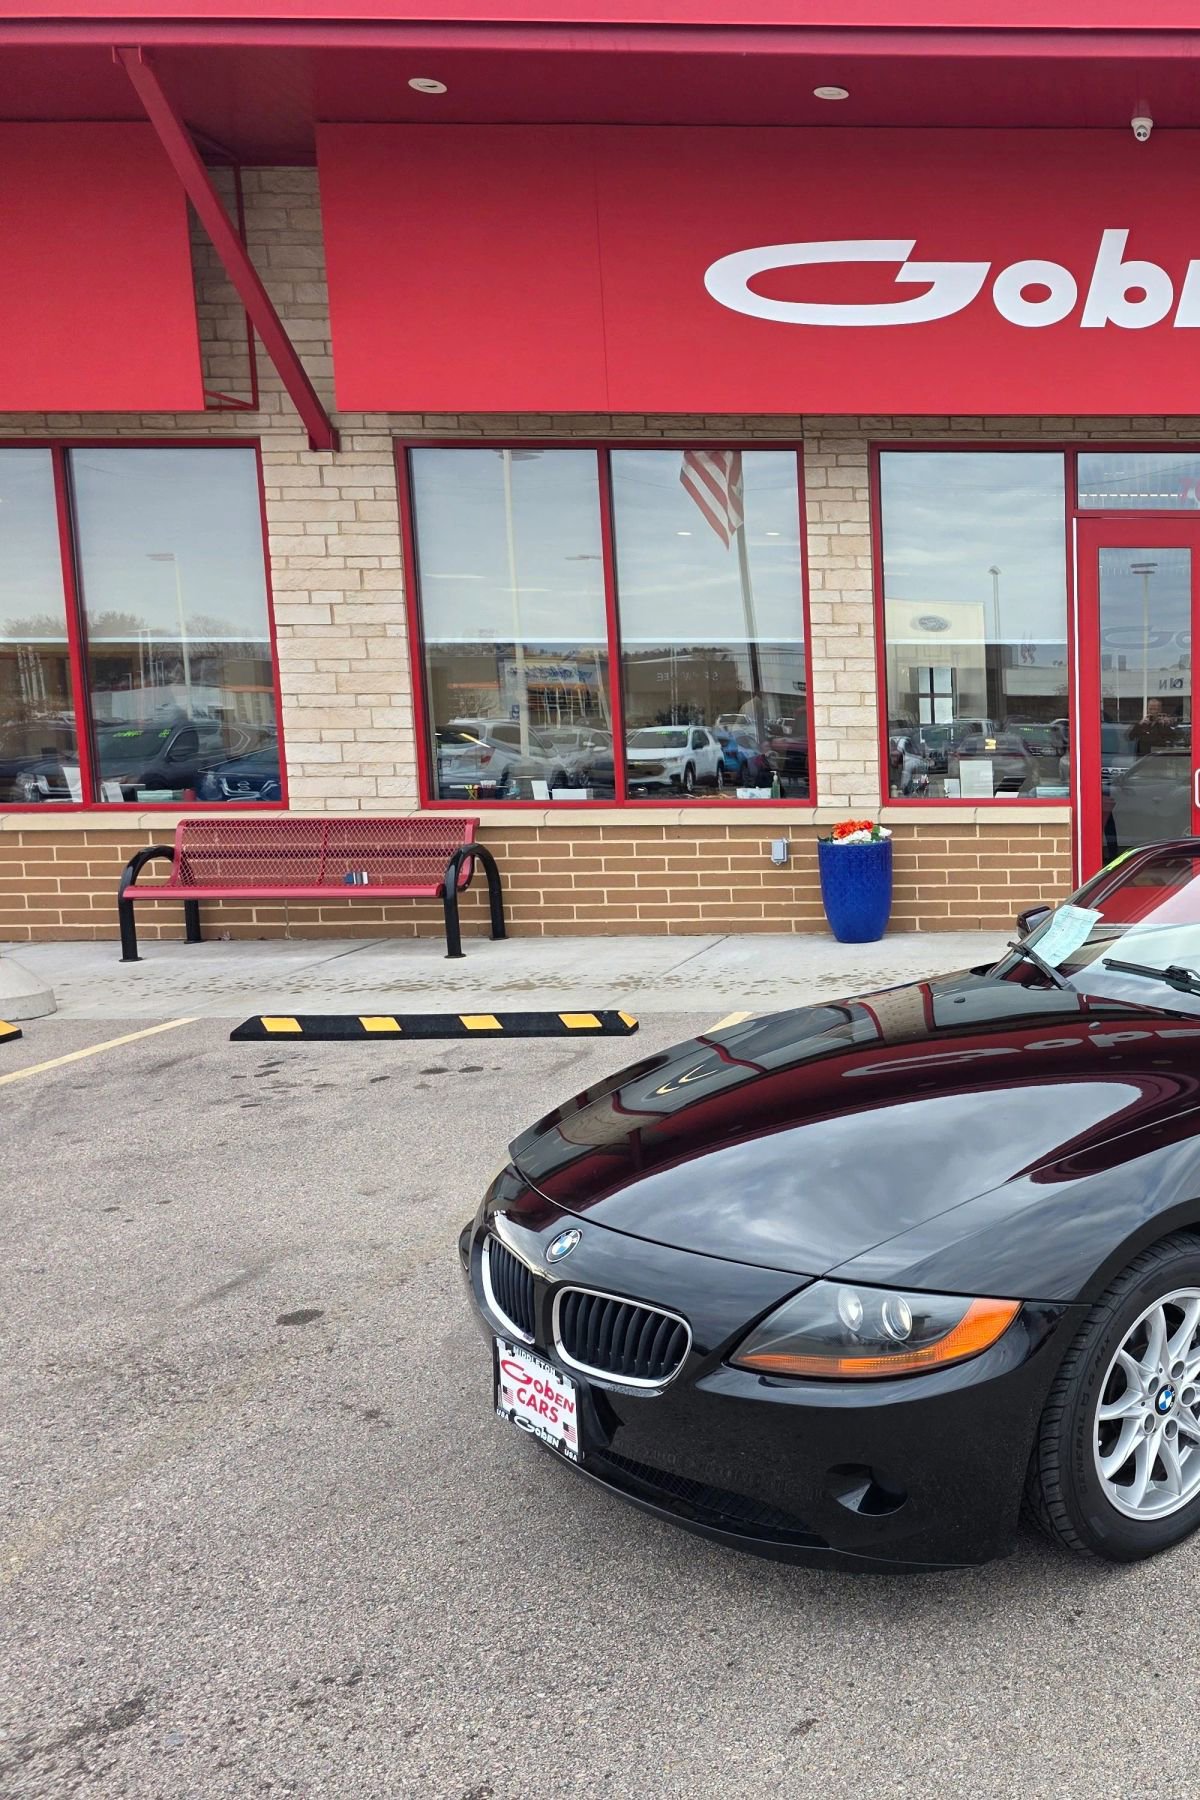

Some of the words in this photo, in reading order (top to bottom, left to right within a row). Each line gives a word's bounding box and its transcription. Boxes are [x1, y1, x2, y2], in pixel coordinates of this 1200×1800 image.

[516, 1387, 559, 1424] CARS
[496, 1408, 509, 1421] USA
[564, 1449, 578, 1462] USA
